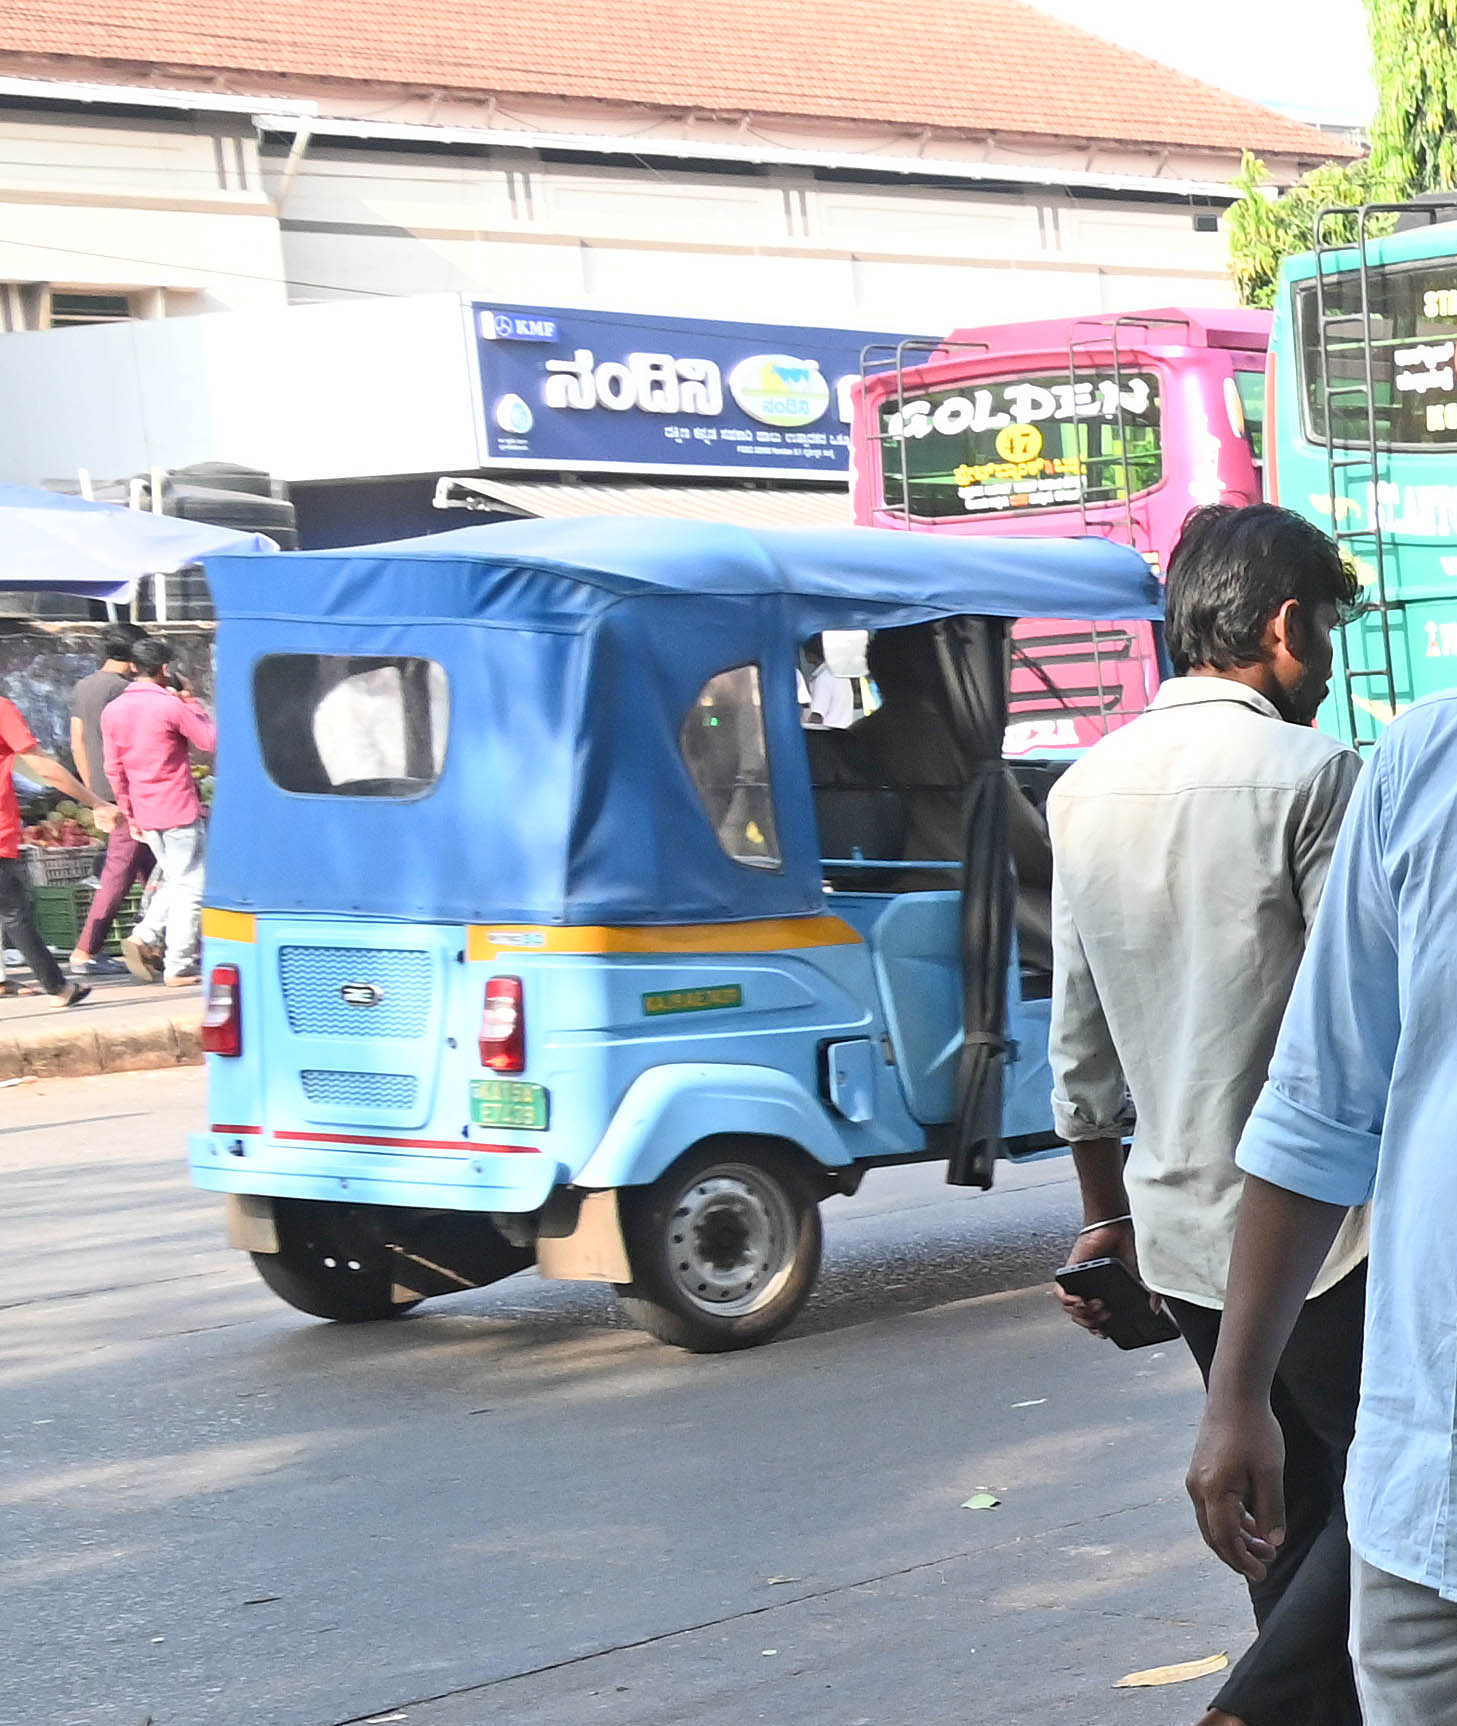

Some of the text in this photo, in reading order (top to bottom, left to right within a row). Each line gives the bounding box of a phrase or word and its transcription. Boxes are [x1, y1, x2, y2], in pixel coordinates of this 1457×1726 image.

[515, 319, 555, 337] KMF
[545, 349, 723, 415] ನಂದಿನಿ
[888, 378, 1150, 440] GOLDEN
